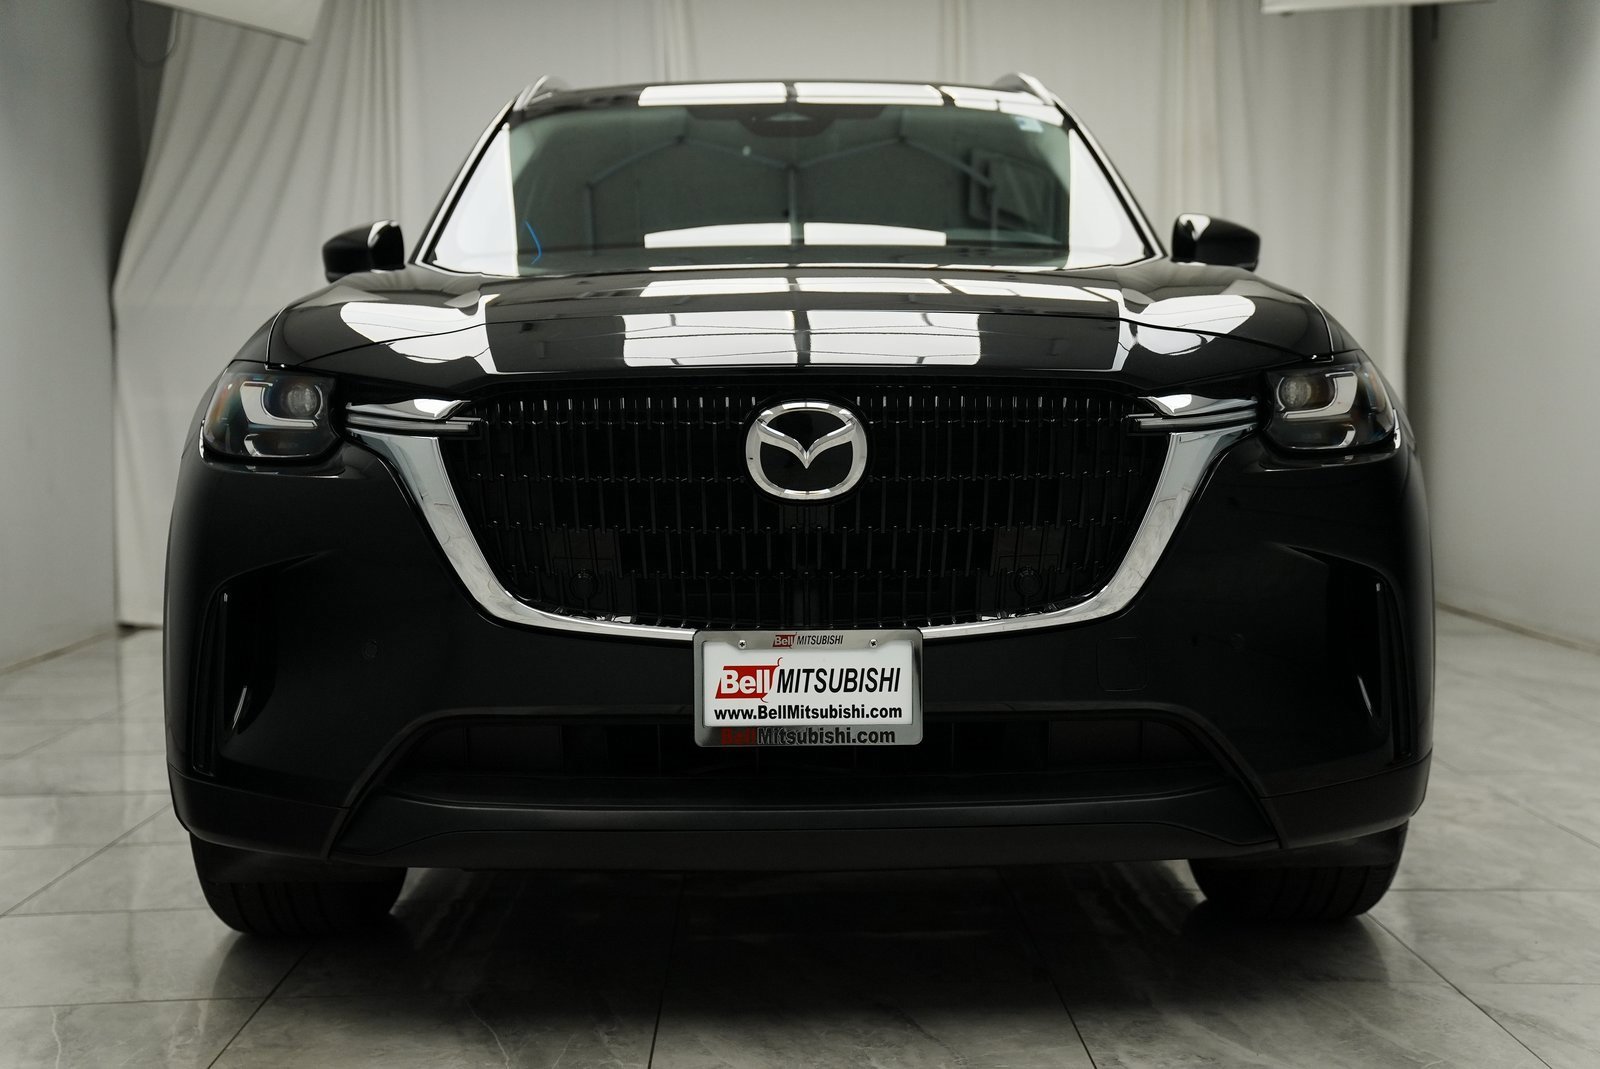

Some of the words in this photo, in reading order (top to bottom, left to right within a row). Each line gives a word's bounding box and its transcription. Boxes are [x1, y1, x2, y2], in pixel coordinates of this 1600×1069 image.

[774, 635, 795, 647] Bell
[796, 634, 844, 646] MITSUBISHI
[720, 668, 771, 694] Bell
[776, 667, 901, 694] MITSUBISHI
[714, 704, 902, 720] www.BellMitsubishi.com
[721, 727, 896, 745] BellMitsubishi.com
